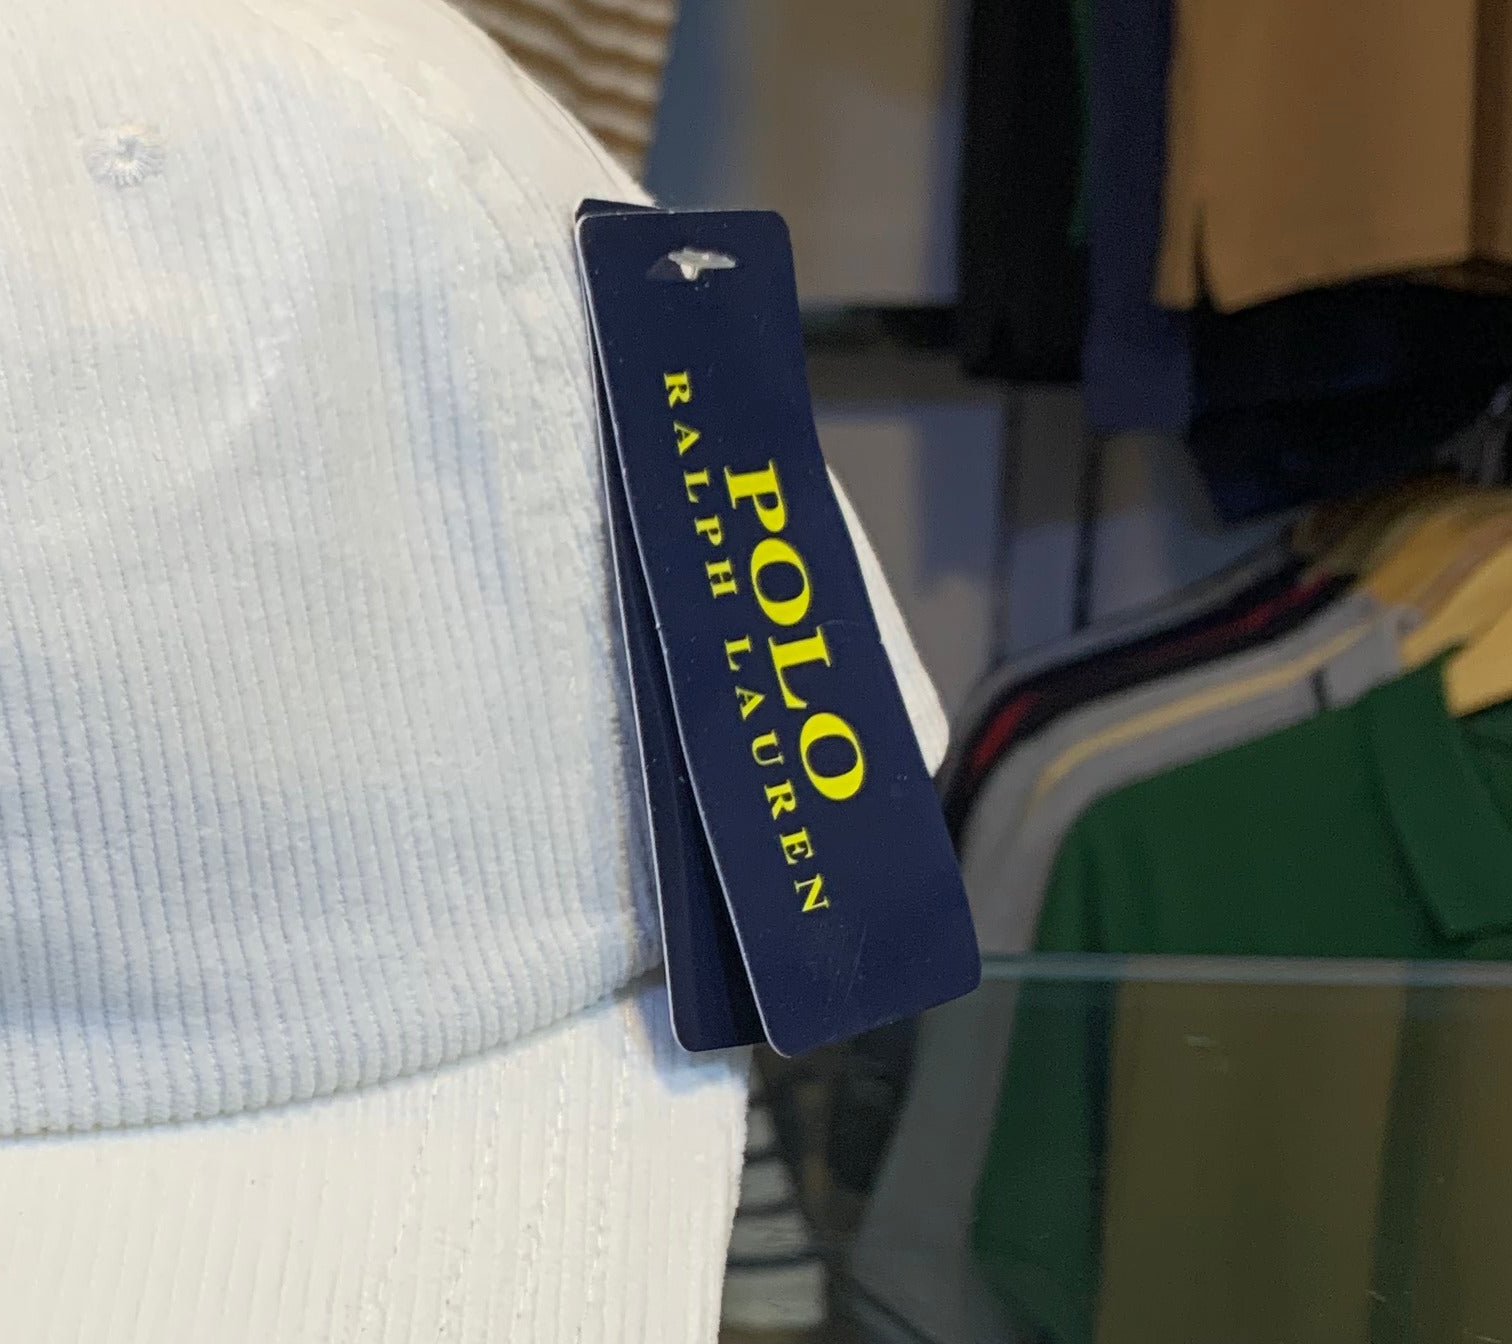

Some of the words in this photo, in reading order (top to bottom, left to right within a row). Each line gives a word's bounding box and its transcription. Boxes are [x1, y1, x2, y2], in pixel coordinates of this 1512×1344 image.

[663, 370, 739, 599] RALPH
[724, 635, 830, 913] LAUREN
[723, 459, 866, 802] POLO
